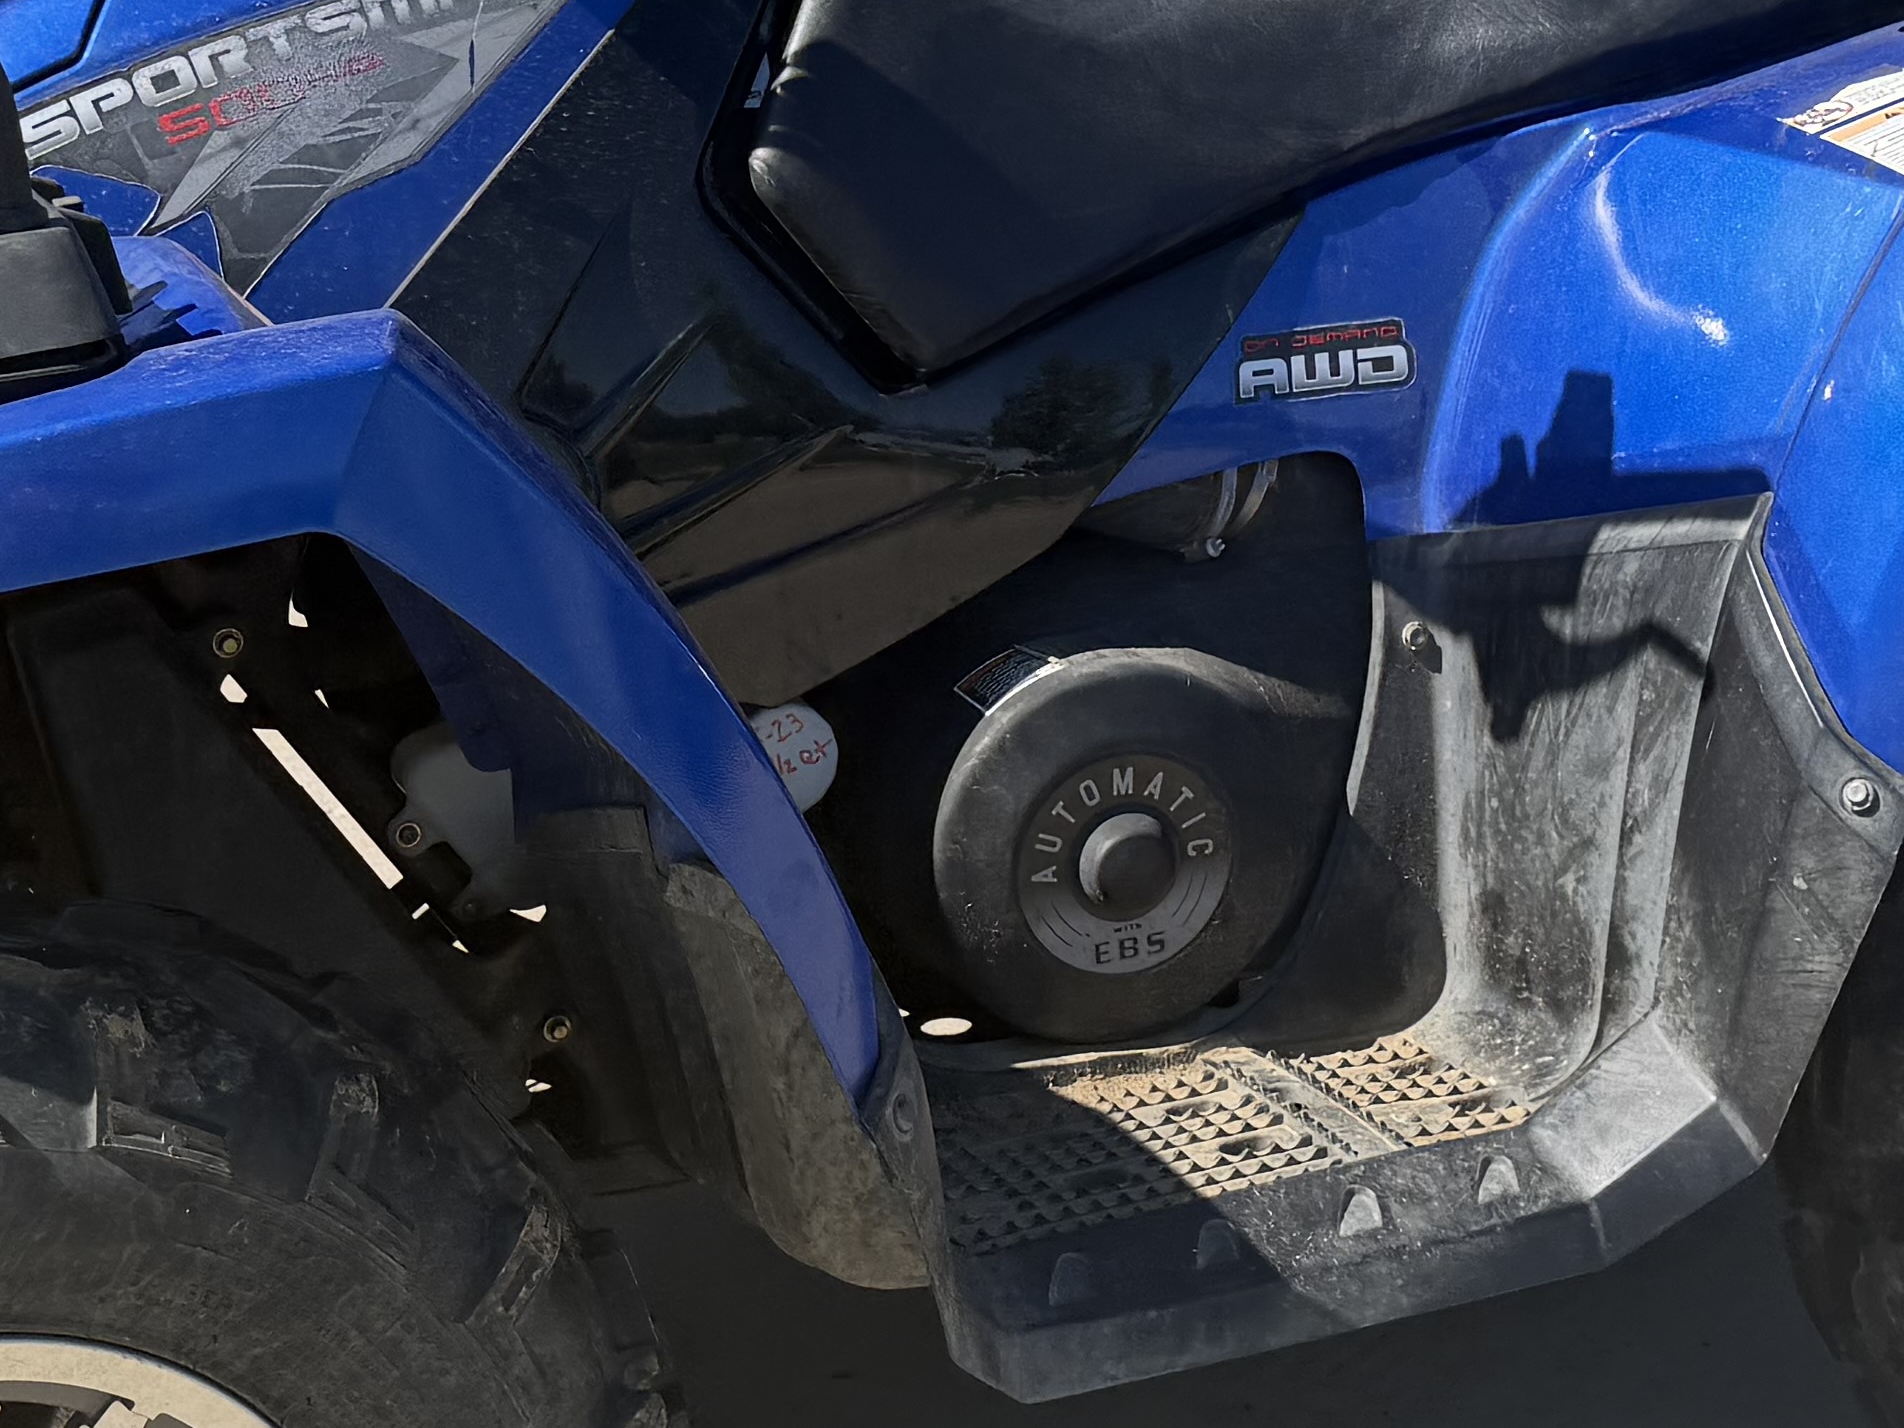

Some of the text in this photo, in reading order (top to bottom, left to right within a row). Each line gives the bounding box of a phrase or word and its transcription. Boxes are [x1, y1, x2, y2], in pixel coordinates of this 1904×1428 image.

[1245, 325, 1398, 353] ON DEMAND
[1239, 344, 1409, 399] AWD
[1031, 767, 1214, 883] AUTOMATIC
[1094, 930, 1166, 965] EBS
